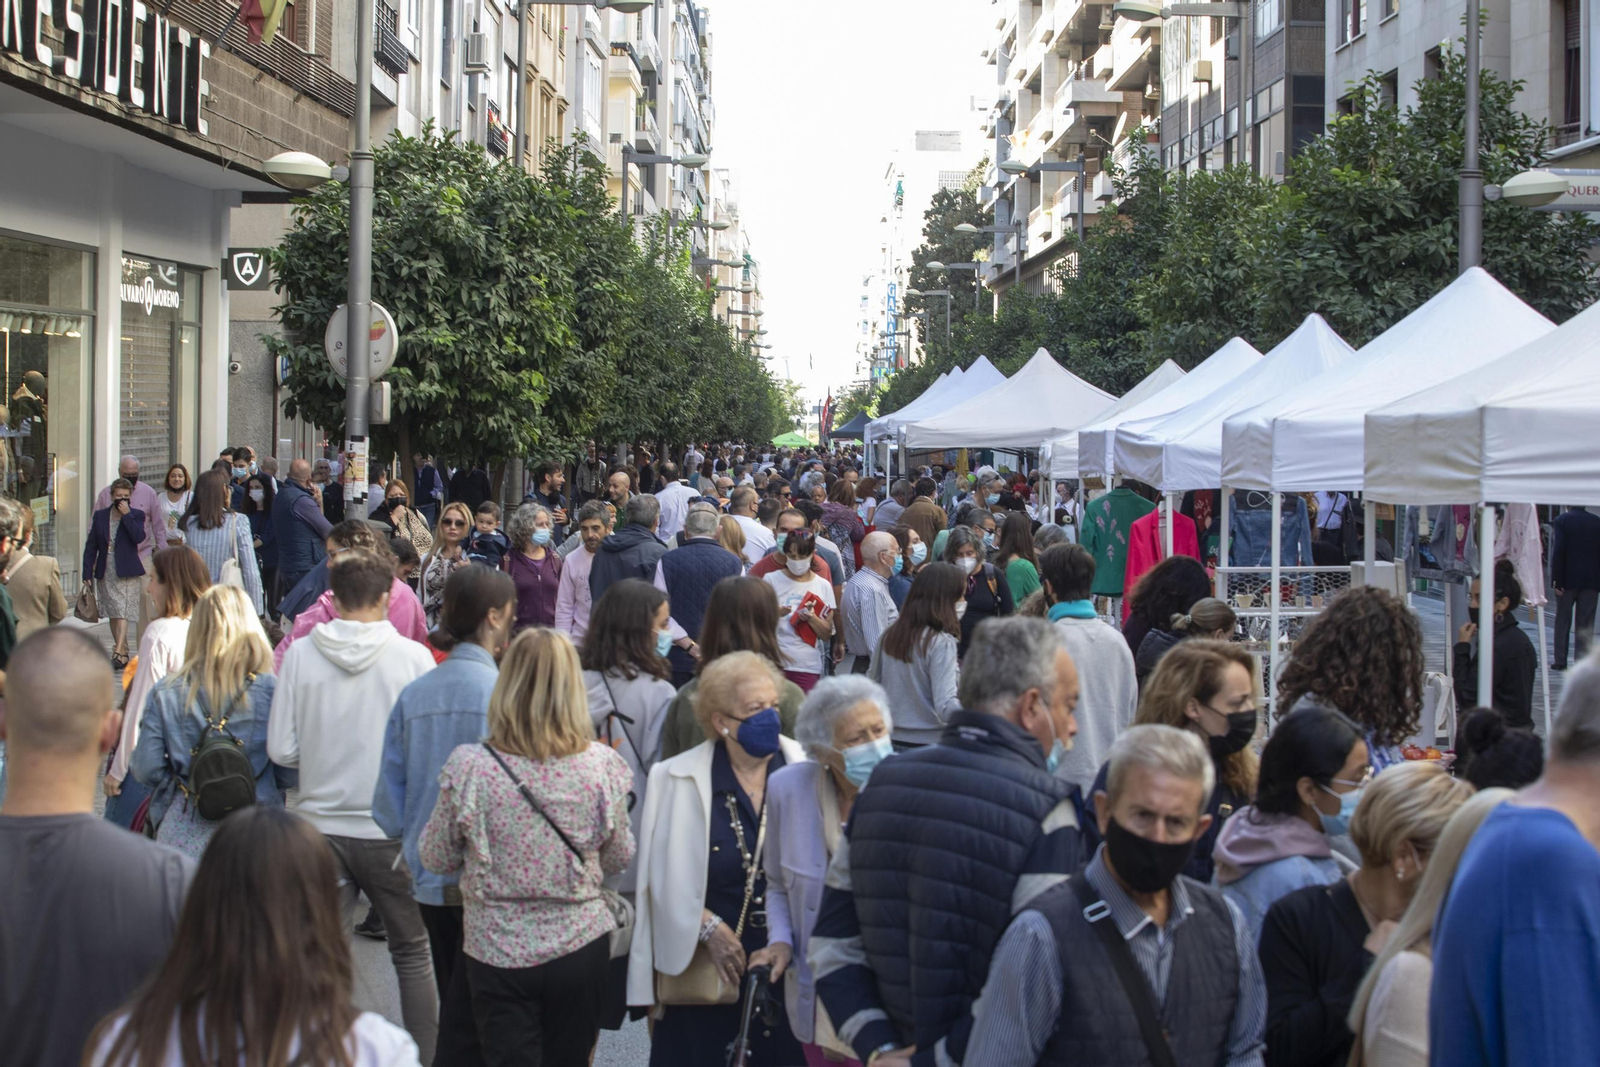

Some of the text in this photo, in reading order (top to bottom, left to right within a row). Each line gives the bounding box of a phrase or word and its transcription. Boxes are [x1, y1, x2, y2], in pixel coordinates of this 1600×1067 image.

[241, 257, 255, 276] A
[120, 283, 145, 304] ALVARO
[153, 288, 180, 309] MORENO
